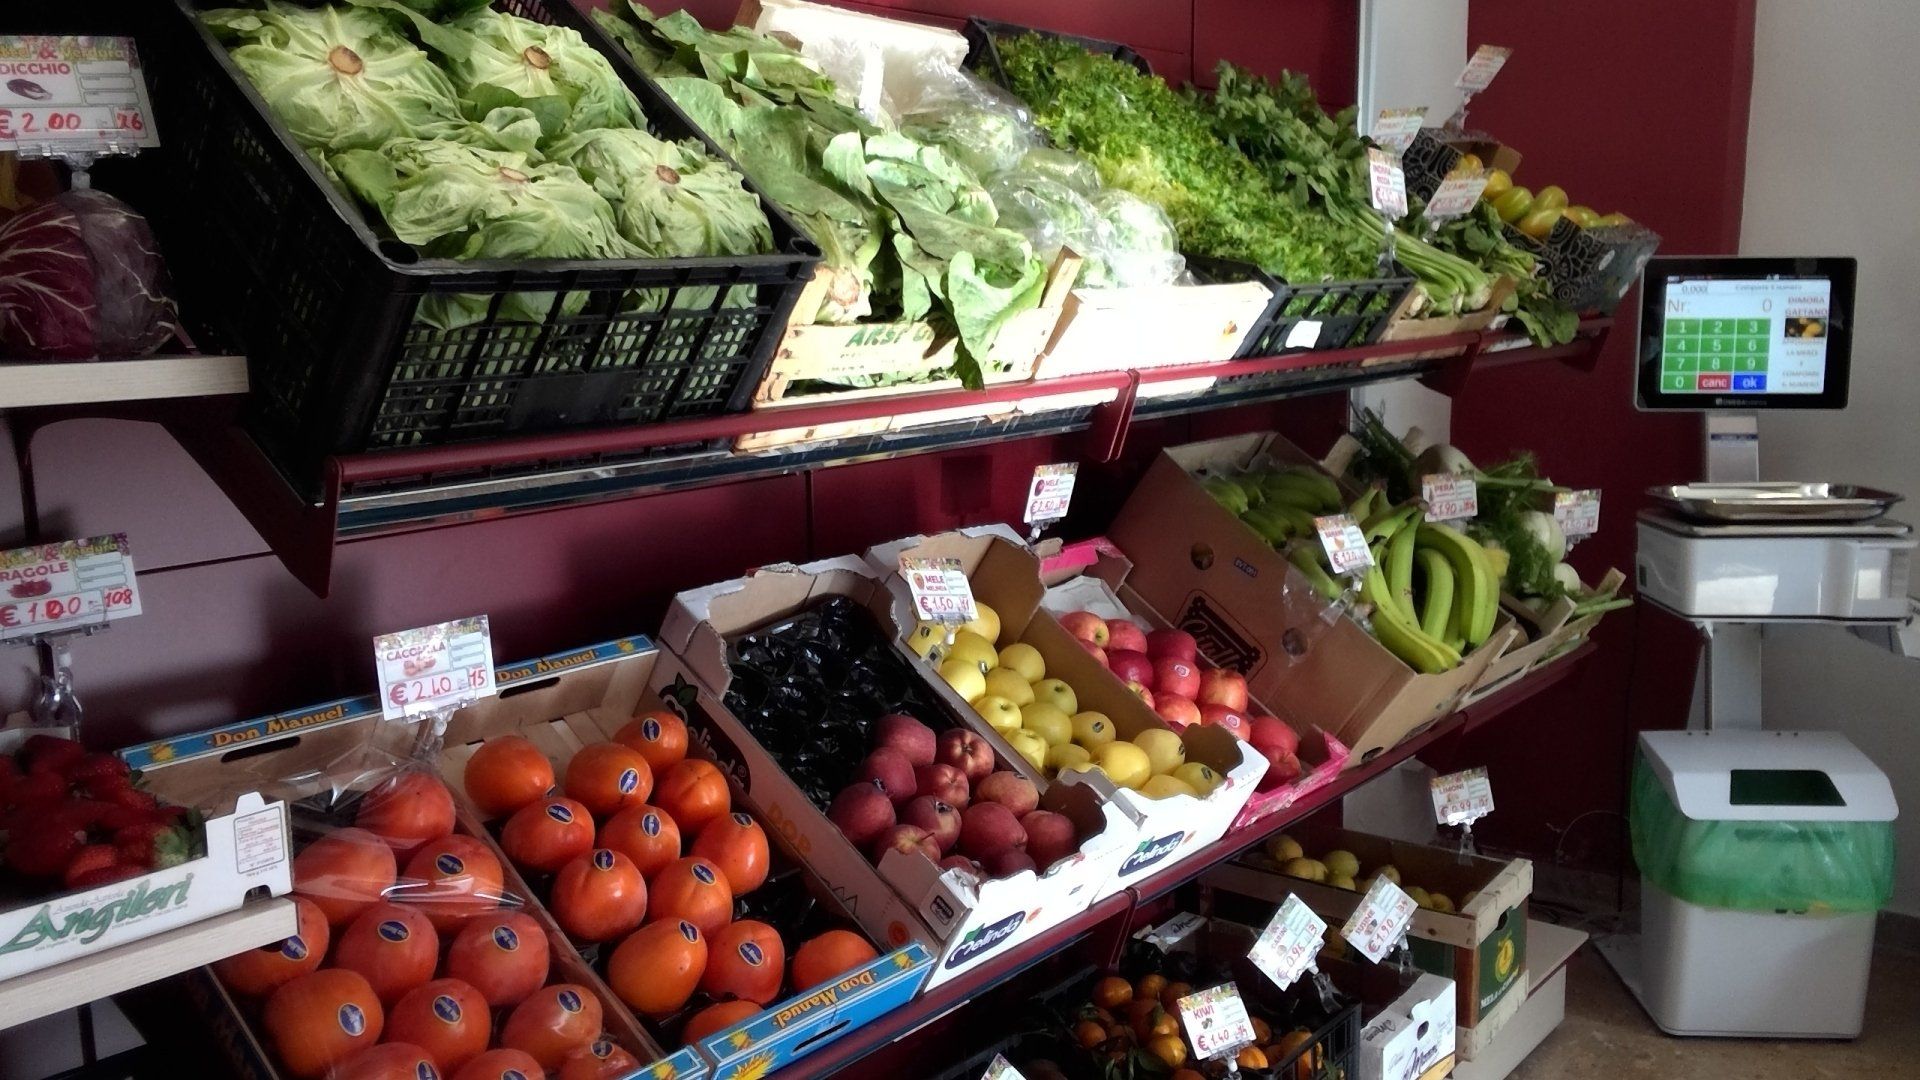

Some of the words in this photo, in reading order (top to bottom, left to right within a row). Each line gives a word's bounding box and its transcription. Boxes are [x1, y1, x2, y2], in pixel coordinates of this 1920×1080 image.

[1714, 321, 1722, 333] 2
[1750, 321, 1758, 333] 3
[1677, 340, 1686, 352] 4
[1713, 340, 1721, 351] 5
[1748, 340, 1757, 352] 6
[1678, 358, 1685, 370] 7
[1712, 358, 1720, 370] 8
[1747, 358, 1756, 370] 9
[1675, 376, 1684, 388] 0
[1701, 377, 1728, 388] canc
[1742, 376, 1758, 388] ok
[0, 604, 21, 628] €
[498, 668, 533, 682] Don
[536, 649, 597, 673] Manuel
[389, 682, 409, 705] €
[213, 727, 261, 747] Don
[266, 705, 345, 735] Manuel
[838, 971, 875, 990] Don
[776, 989, 840, 1029] Manuel
[1193, 1005, 1215, 1020] KIWI
